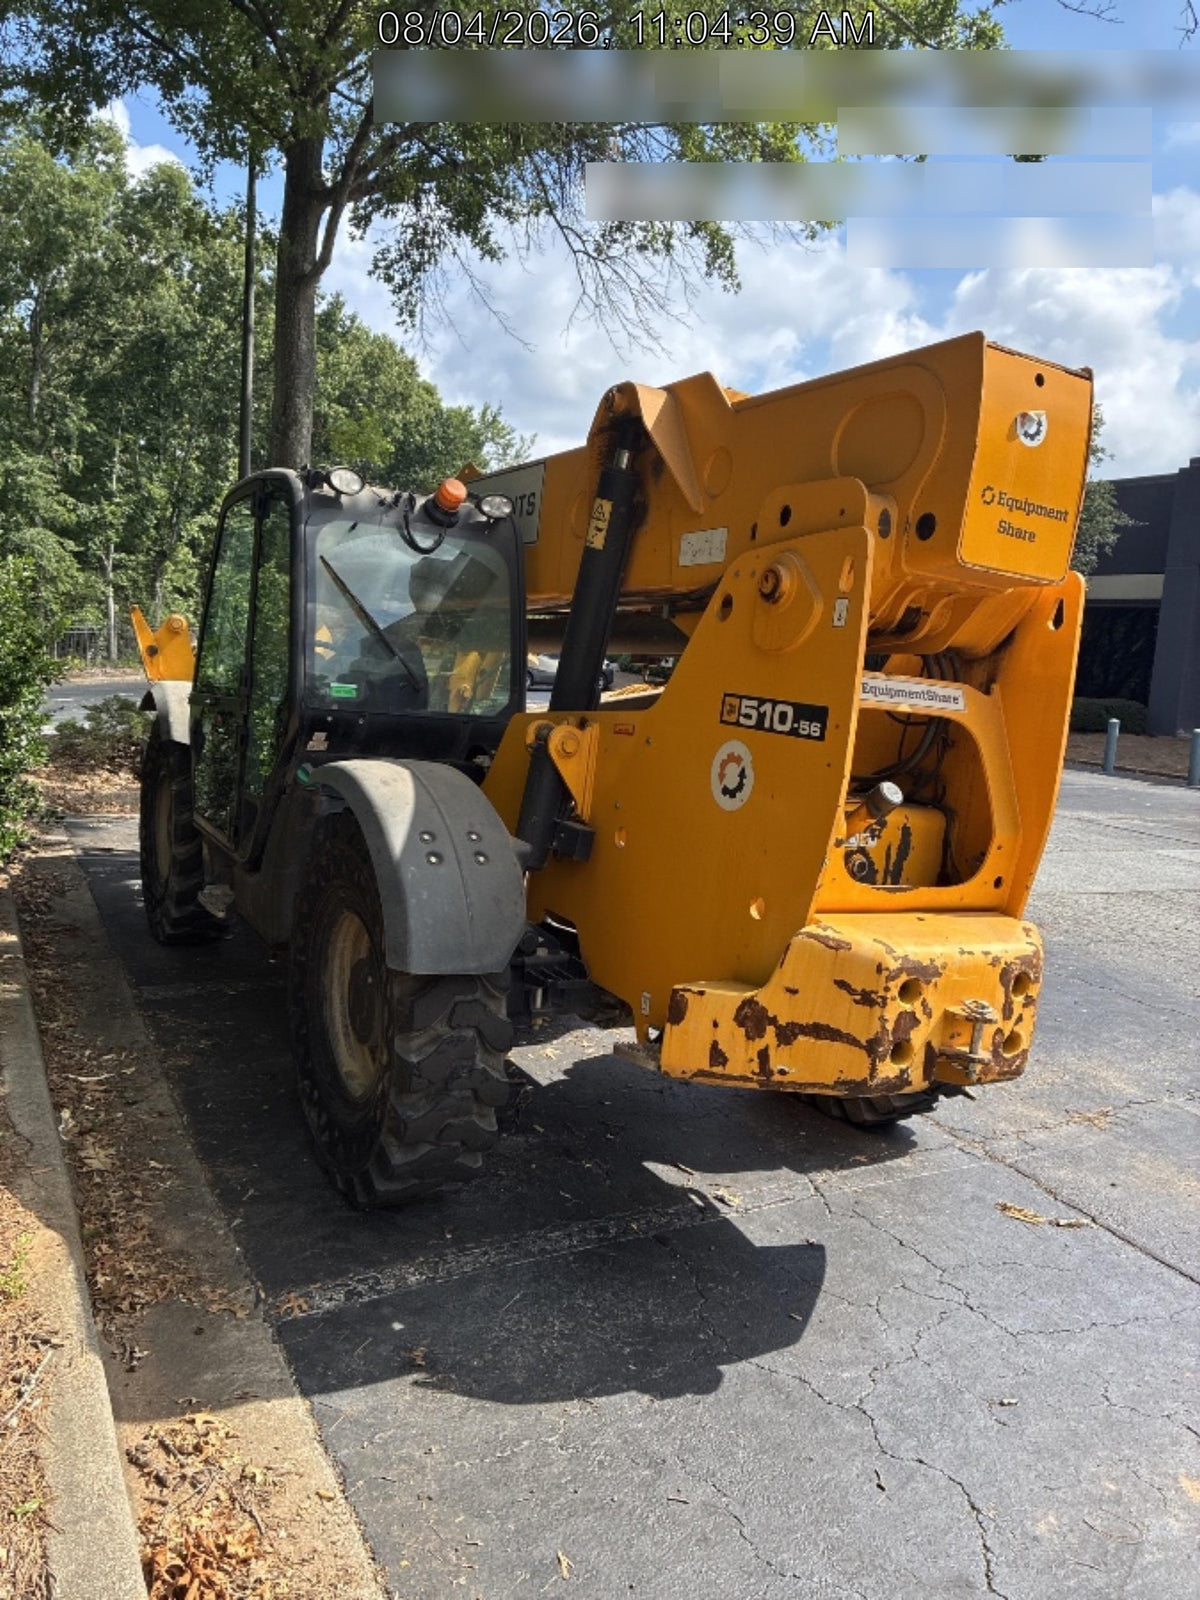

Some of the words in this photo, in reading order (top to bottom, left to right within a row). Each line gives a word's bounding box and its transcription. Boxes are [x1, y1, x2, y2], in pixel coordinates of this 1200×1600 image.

[997, 490, 1069, 524] Equipment
[997, 518, 1037, 543] Share
[861, 682, 960, 705] EquipmentShare
